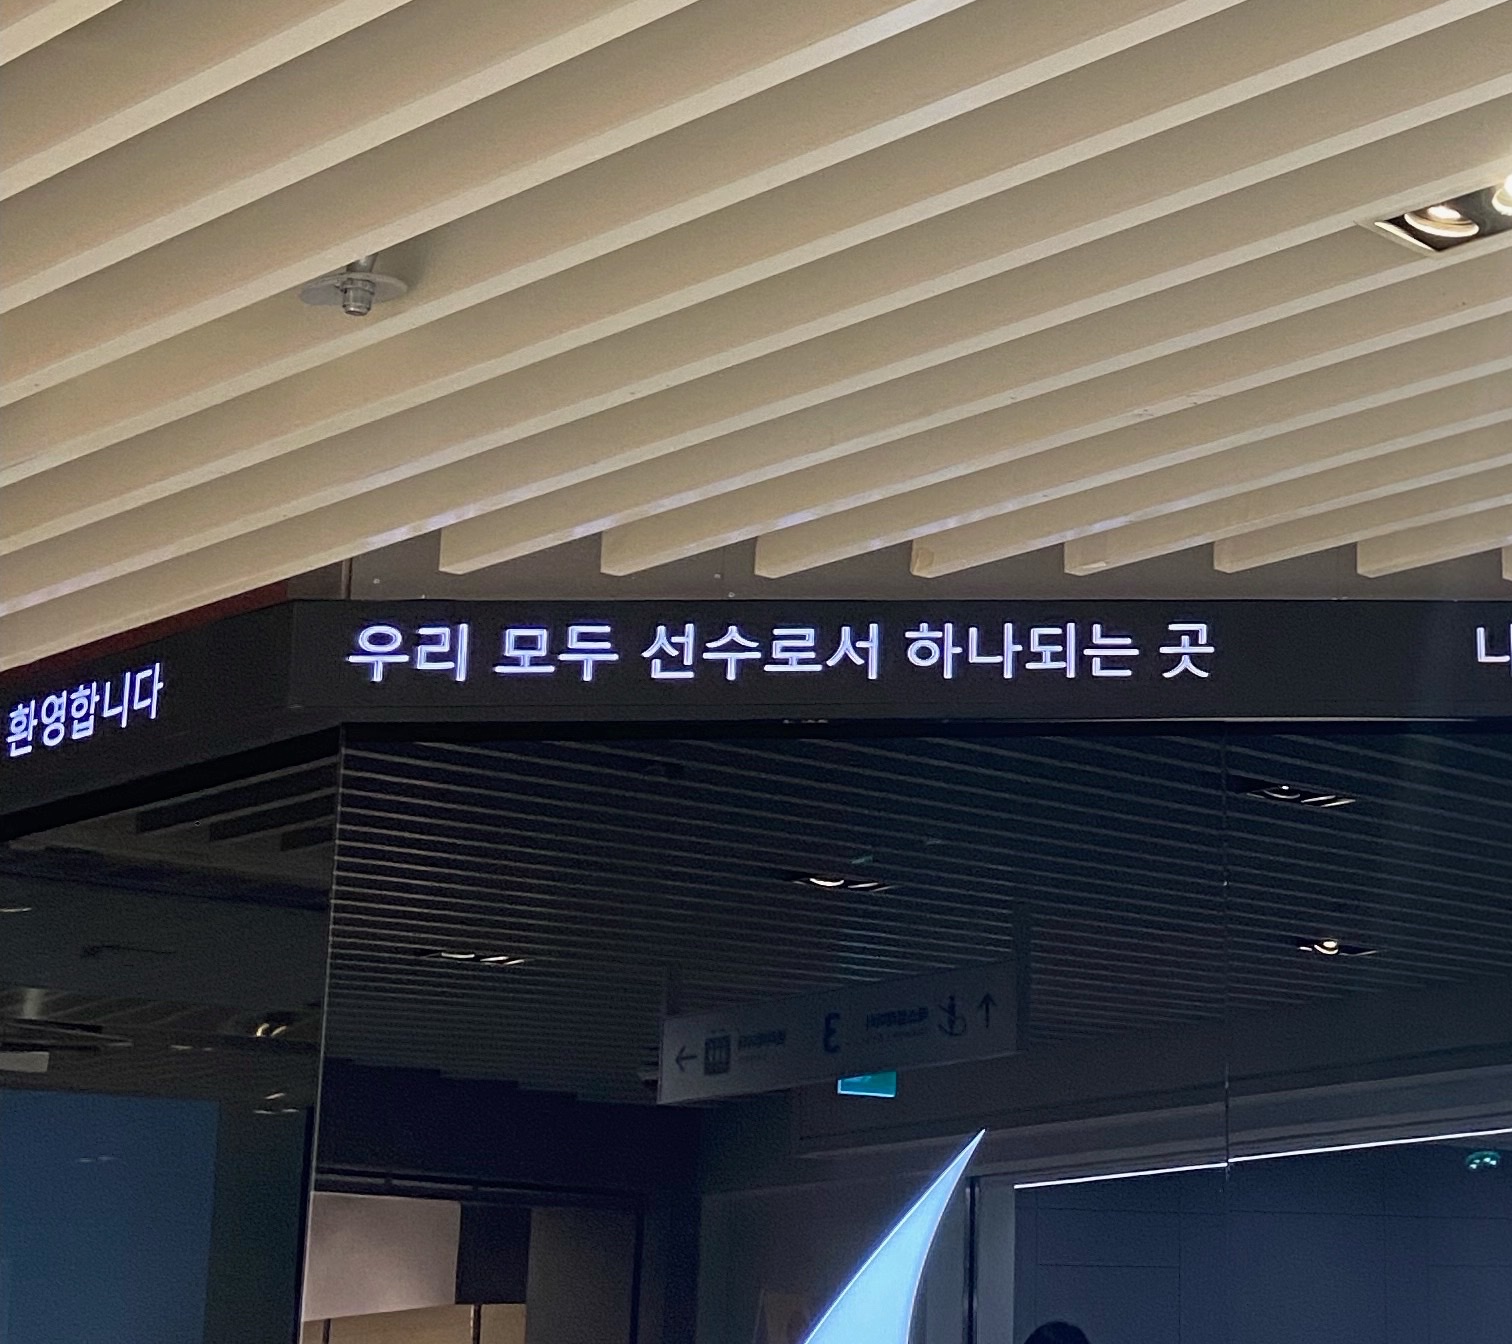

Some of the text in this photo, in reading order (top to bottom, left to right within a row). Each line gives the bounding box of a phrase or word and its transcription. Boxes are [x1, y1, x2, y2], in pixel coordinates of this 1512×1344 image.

[346, 622, 1216, 682] 우리 모두 선수로서 하나되는 곳
[6, 662, 164, 757] 환영합니다
